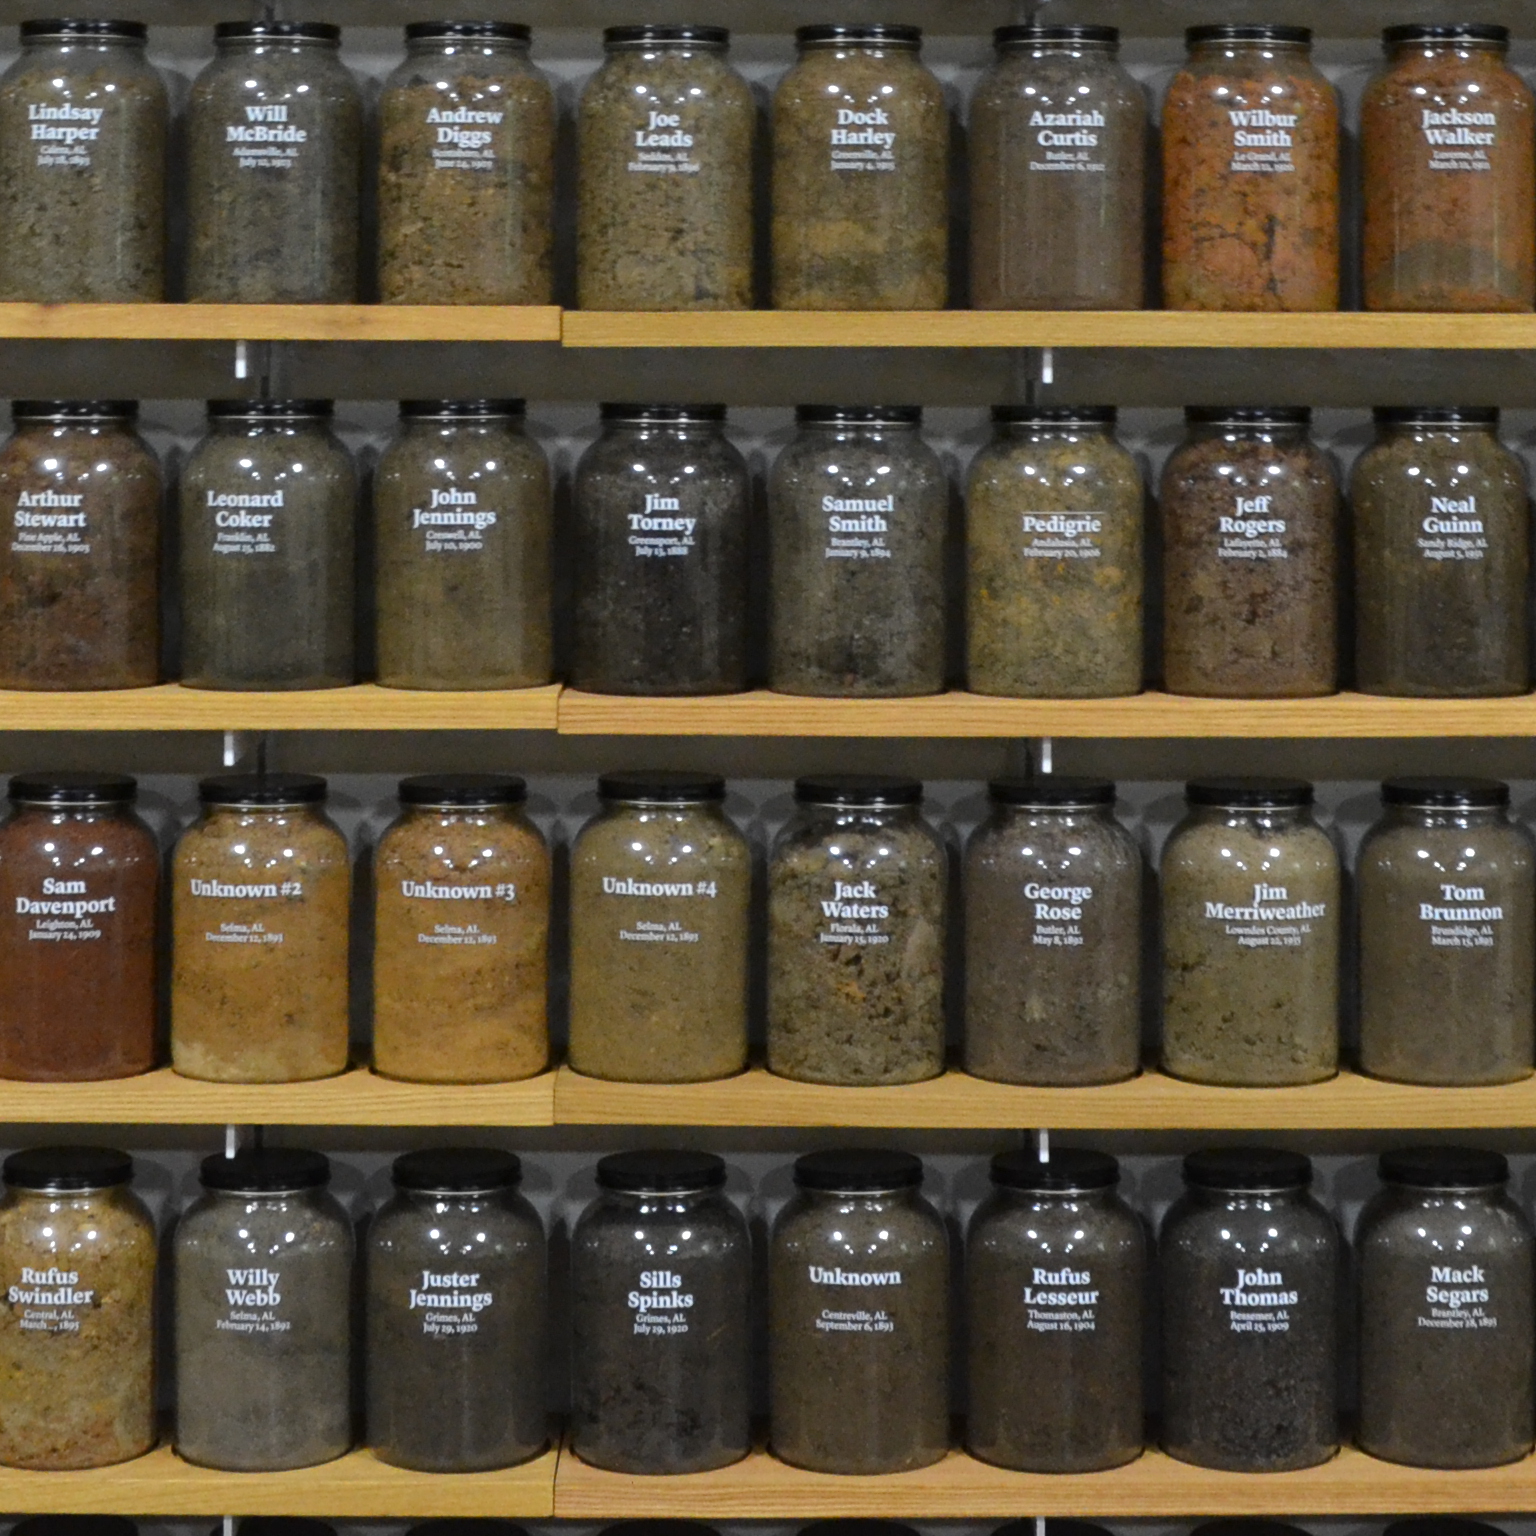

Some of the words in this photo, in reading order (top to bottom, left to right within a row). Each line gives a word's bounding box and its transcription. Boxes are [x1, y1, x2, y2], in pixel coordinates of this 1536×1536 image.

[244, 105, 288, 123] Will
[426, 107, 504, 124] Andrew
[648, 111, 681, 130] Joe
[837, 109, 889, 126] Dock
[1227, 109, 1298, 128] Wilbur
[1421, 108, 1497, 128] Jackson
[226, 125, 307, 142] McBride
[436, 126, 492, 146] Diggs
[635, 130, 694, 147] Leads
[830, 128, 896, 150] Harley
[1234, 129, 1293, 147] Smith
[1424, 128, 1495, 145] Walker
[17, 491, 84, 508] Arthur
[207, 490, 284, 508] Leonard
[430, 488, 477, 508] John
[821, 495, 895, 513] Samuel
[1235, 497, 1273, 517] Jeff
[1431, 496, 1477, 514] Neal
[14, 510, 87, 529] Stewart
[215, 510, 273, 528] Coker
[413, 507, 497, 528] Jennings
[828, 515, 888, 533] Smith
[1022, 516, 1102, 536] Pedigrie
[1219, 516, 1286, 536] Rogers
[1422, 516, 1484, 534] Guinn
[42, 878, 87, 895] Sam
[190, 880, 278, 897] Unknown
[280, 880, 303, 896] #2
[401, 882, 493, 899] Unknown
[494, 882, 516, 901] #3
[602, 878, 694, 897] Unknown
[695, 879, 717, 897] #4
[834, 882, 877, 902] Jack
[1023, 883, 1093, 905] George
[1253, 884, 1288, 904] Jim
[1440, 885, 1486, 901] Tom
[15, 896, 116, 917] Davenport
[820, 902, 889, 920] Waters
[1034, 904, 1082, 921] Rose
[1205, 900, 1326, 920] Merriweather
[1419, 903, 1504, 920] Brunnon
[21, 1267, 79, 1285] Rufus
[226, 1269, 280, 1290] Willy
[421, 1270, 480, 1290] Juster
[639, 1270, 682, 1288] Sills
[808, 1267, 902, 1285] Unknown
[1032, 1268, 1091, 1286] Rufus
[1234, 1269, 1283, 1289] John
[1430, 1266, 1485, 1284] Mack
[8, 1286, 94, 1305] Swindler
[225, 1288, 281, 1307] Webb
[409, 1290, 493, 1311] Jennings
[627, 1290, 694, 1311] Spinks
[1023, 1287, 1100, 1305] Lesseur
[1219, 1287, 1299, 1306] Thomas
[1426, 1285, 1489, 1307] Segars
